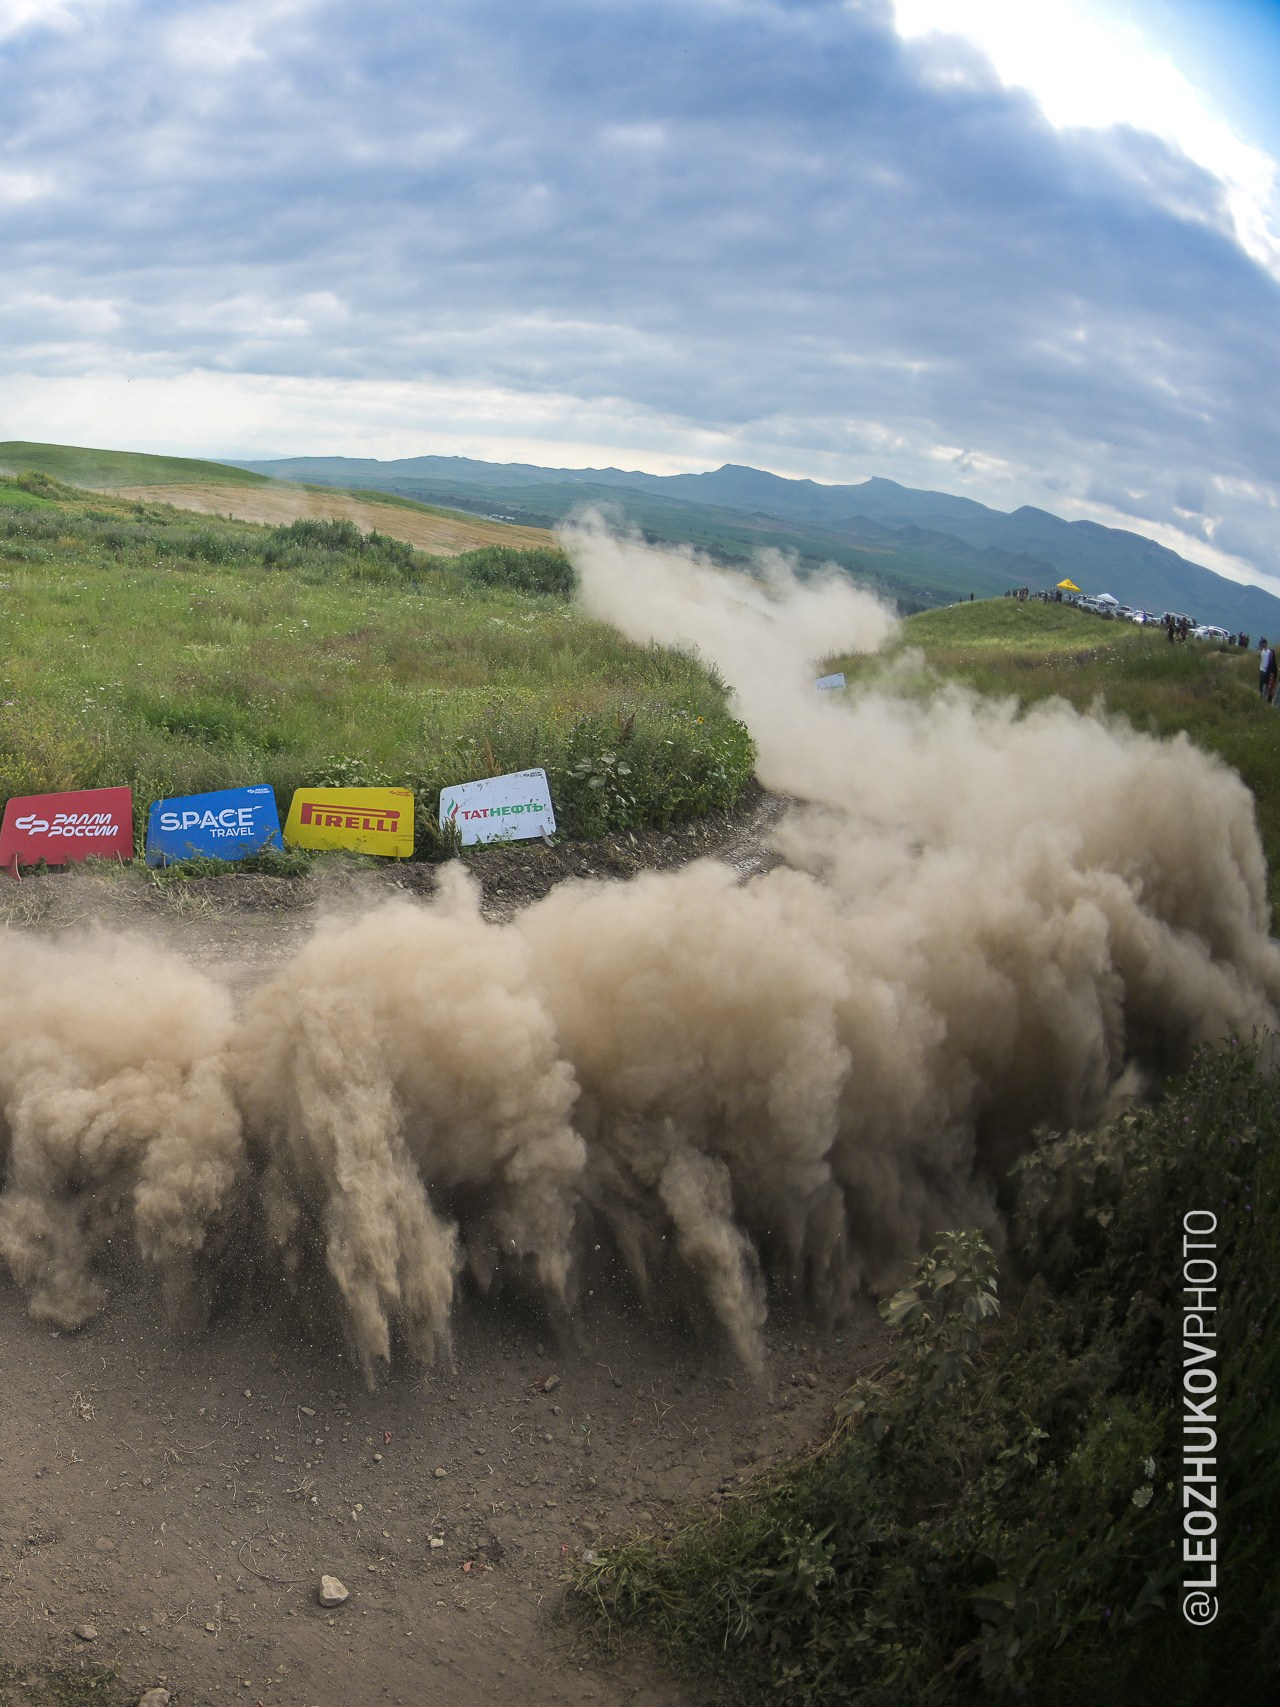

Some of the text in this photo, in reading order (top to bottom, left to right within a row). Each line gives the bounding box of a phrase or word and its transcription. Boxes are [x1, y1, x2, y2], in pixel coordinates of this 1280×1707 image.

[53, 813, 112, 825] РАЛЛИ
[160, 807, 255, 831] SPACE
[300, 803, 401, 833] PIRELLI
[462, 803, 544, 820] ТАТНЕФТЬ
[47, 824, 119, 838] РОССИИ
[210, 826, 255, 838] TRAVEL
